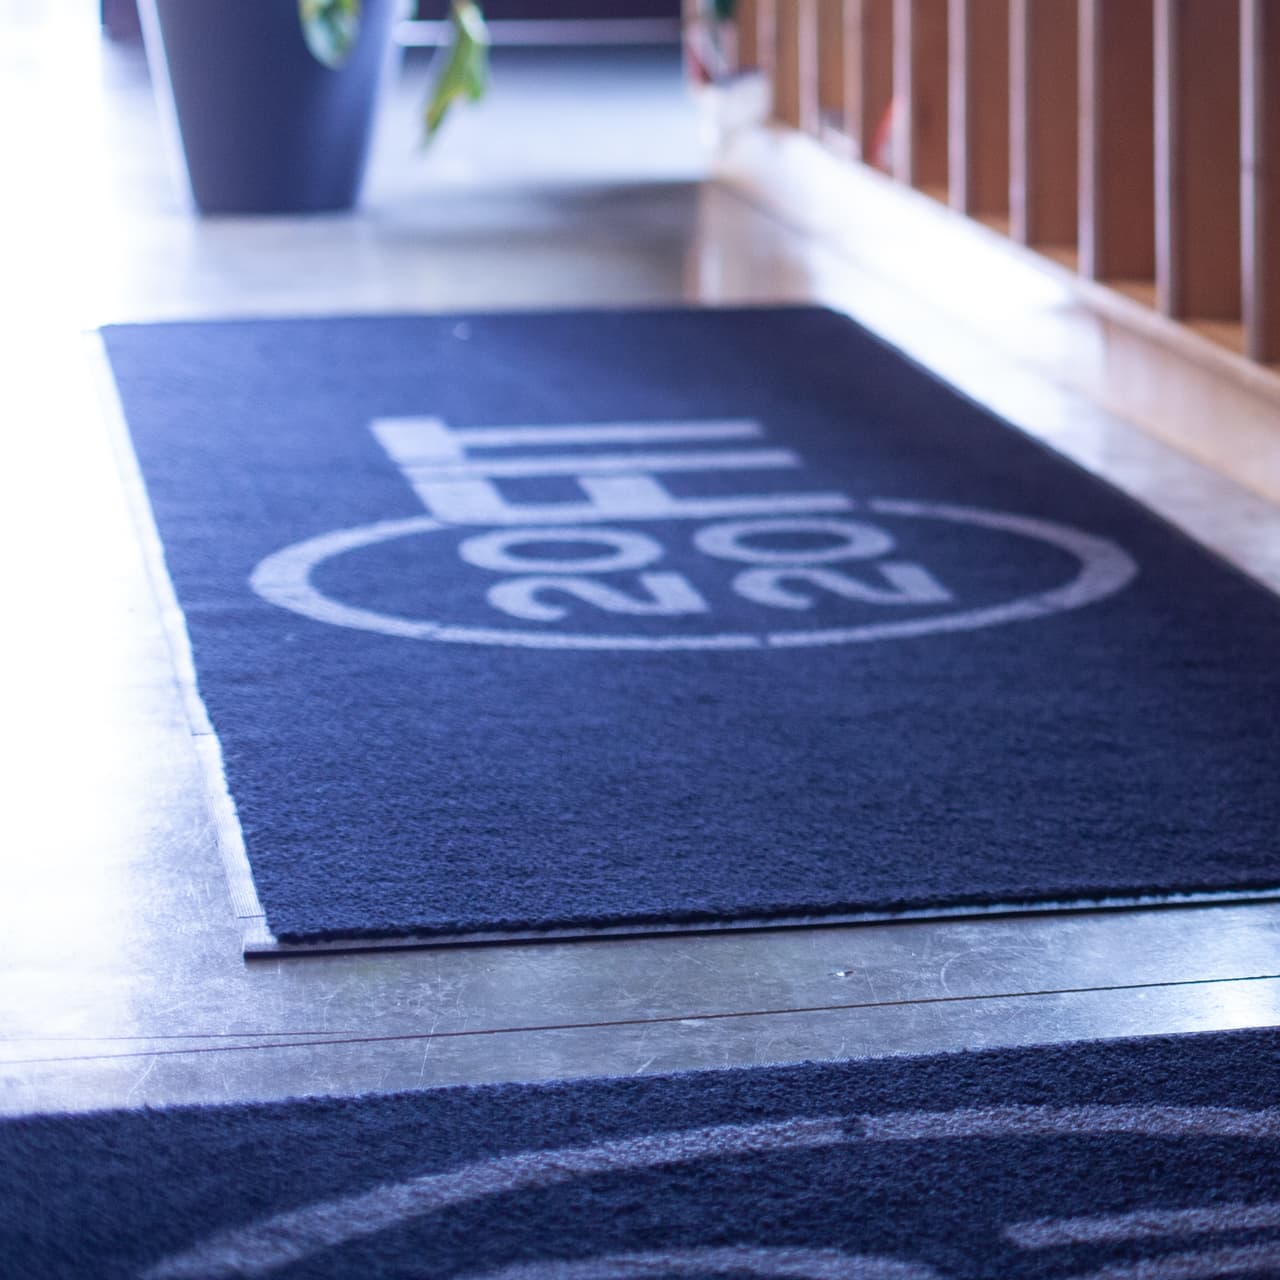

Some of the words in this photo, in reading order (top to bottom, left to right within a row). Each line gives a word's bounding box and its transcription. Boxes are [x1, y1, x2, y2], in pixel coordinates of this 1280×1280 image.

[369, 417, 855, 523] FIT
[458, 526, 710, 621] 20
[692, 518, 954, 610] 20
